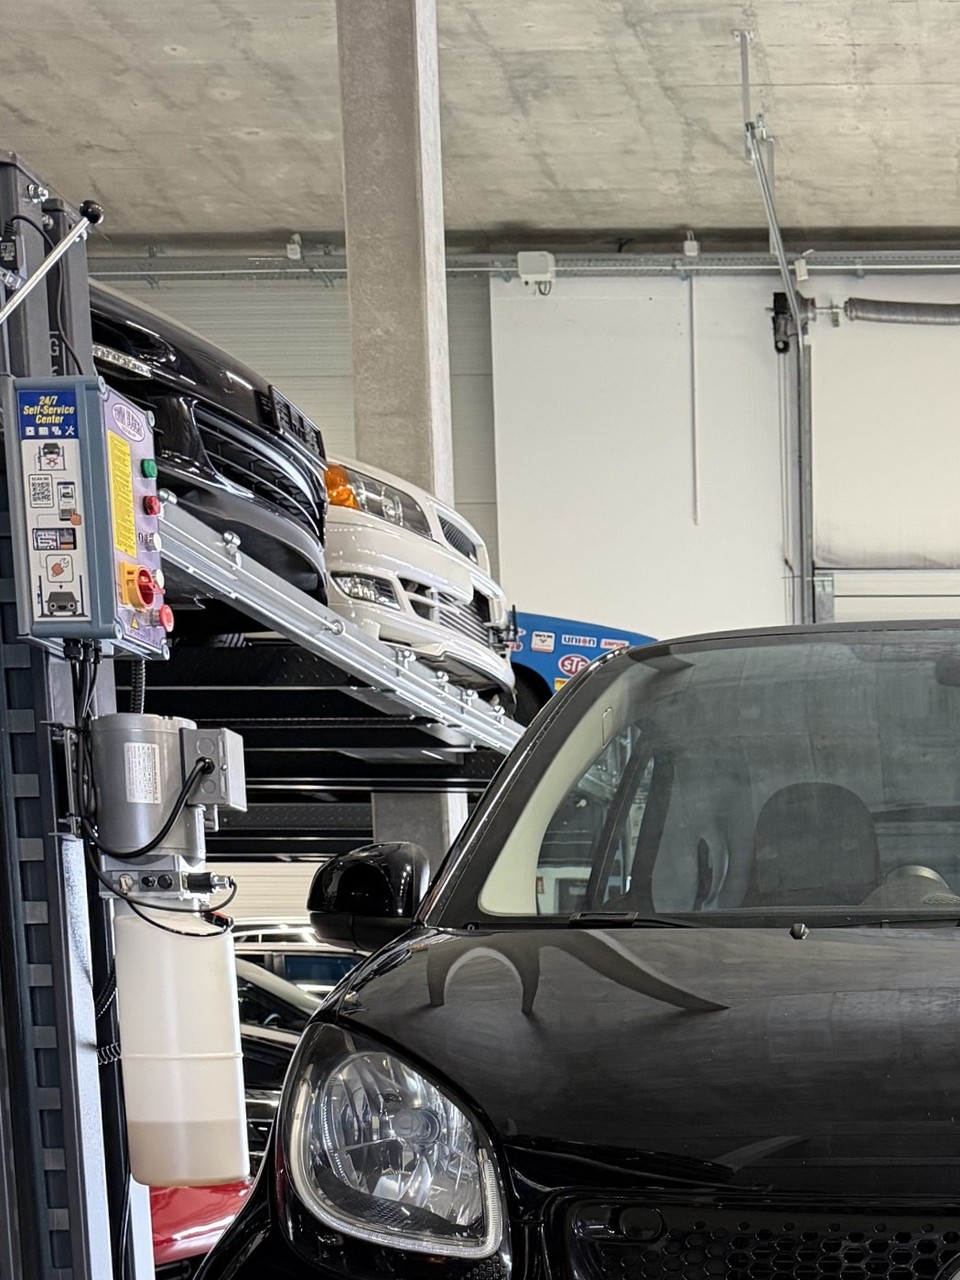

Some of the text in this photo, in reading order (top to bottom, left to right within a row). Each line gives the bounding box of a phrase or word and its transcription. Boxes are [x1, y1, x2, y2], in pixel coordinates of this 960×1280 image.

[39, 395, 59, 405] 24/7
[23, 405, 75, 415] Self-Service
[35, 414, 64, 424] Center
